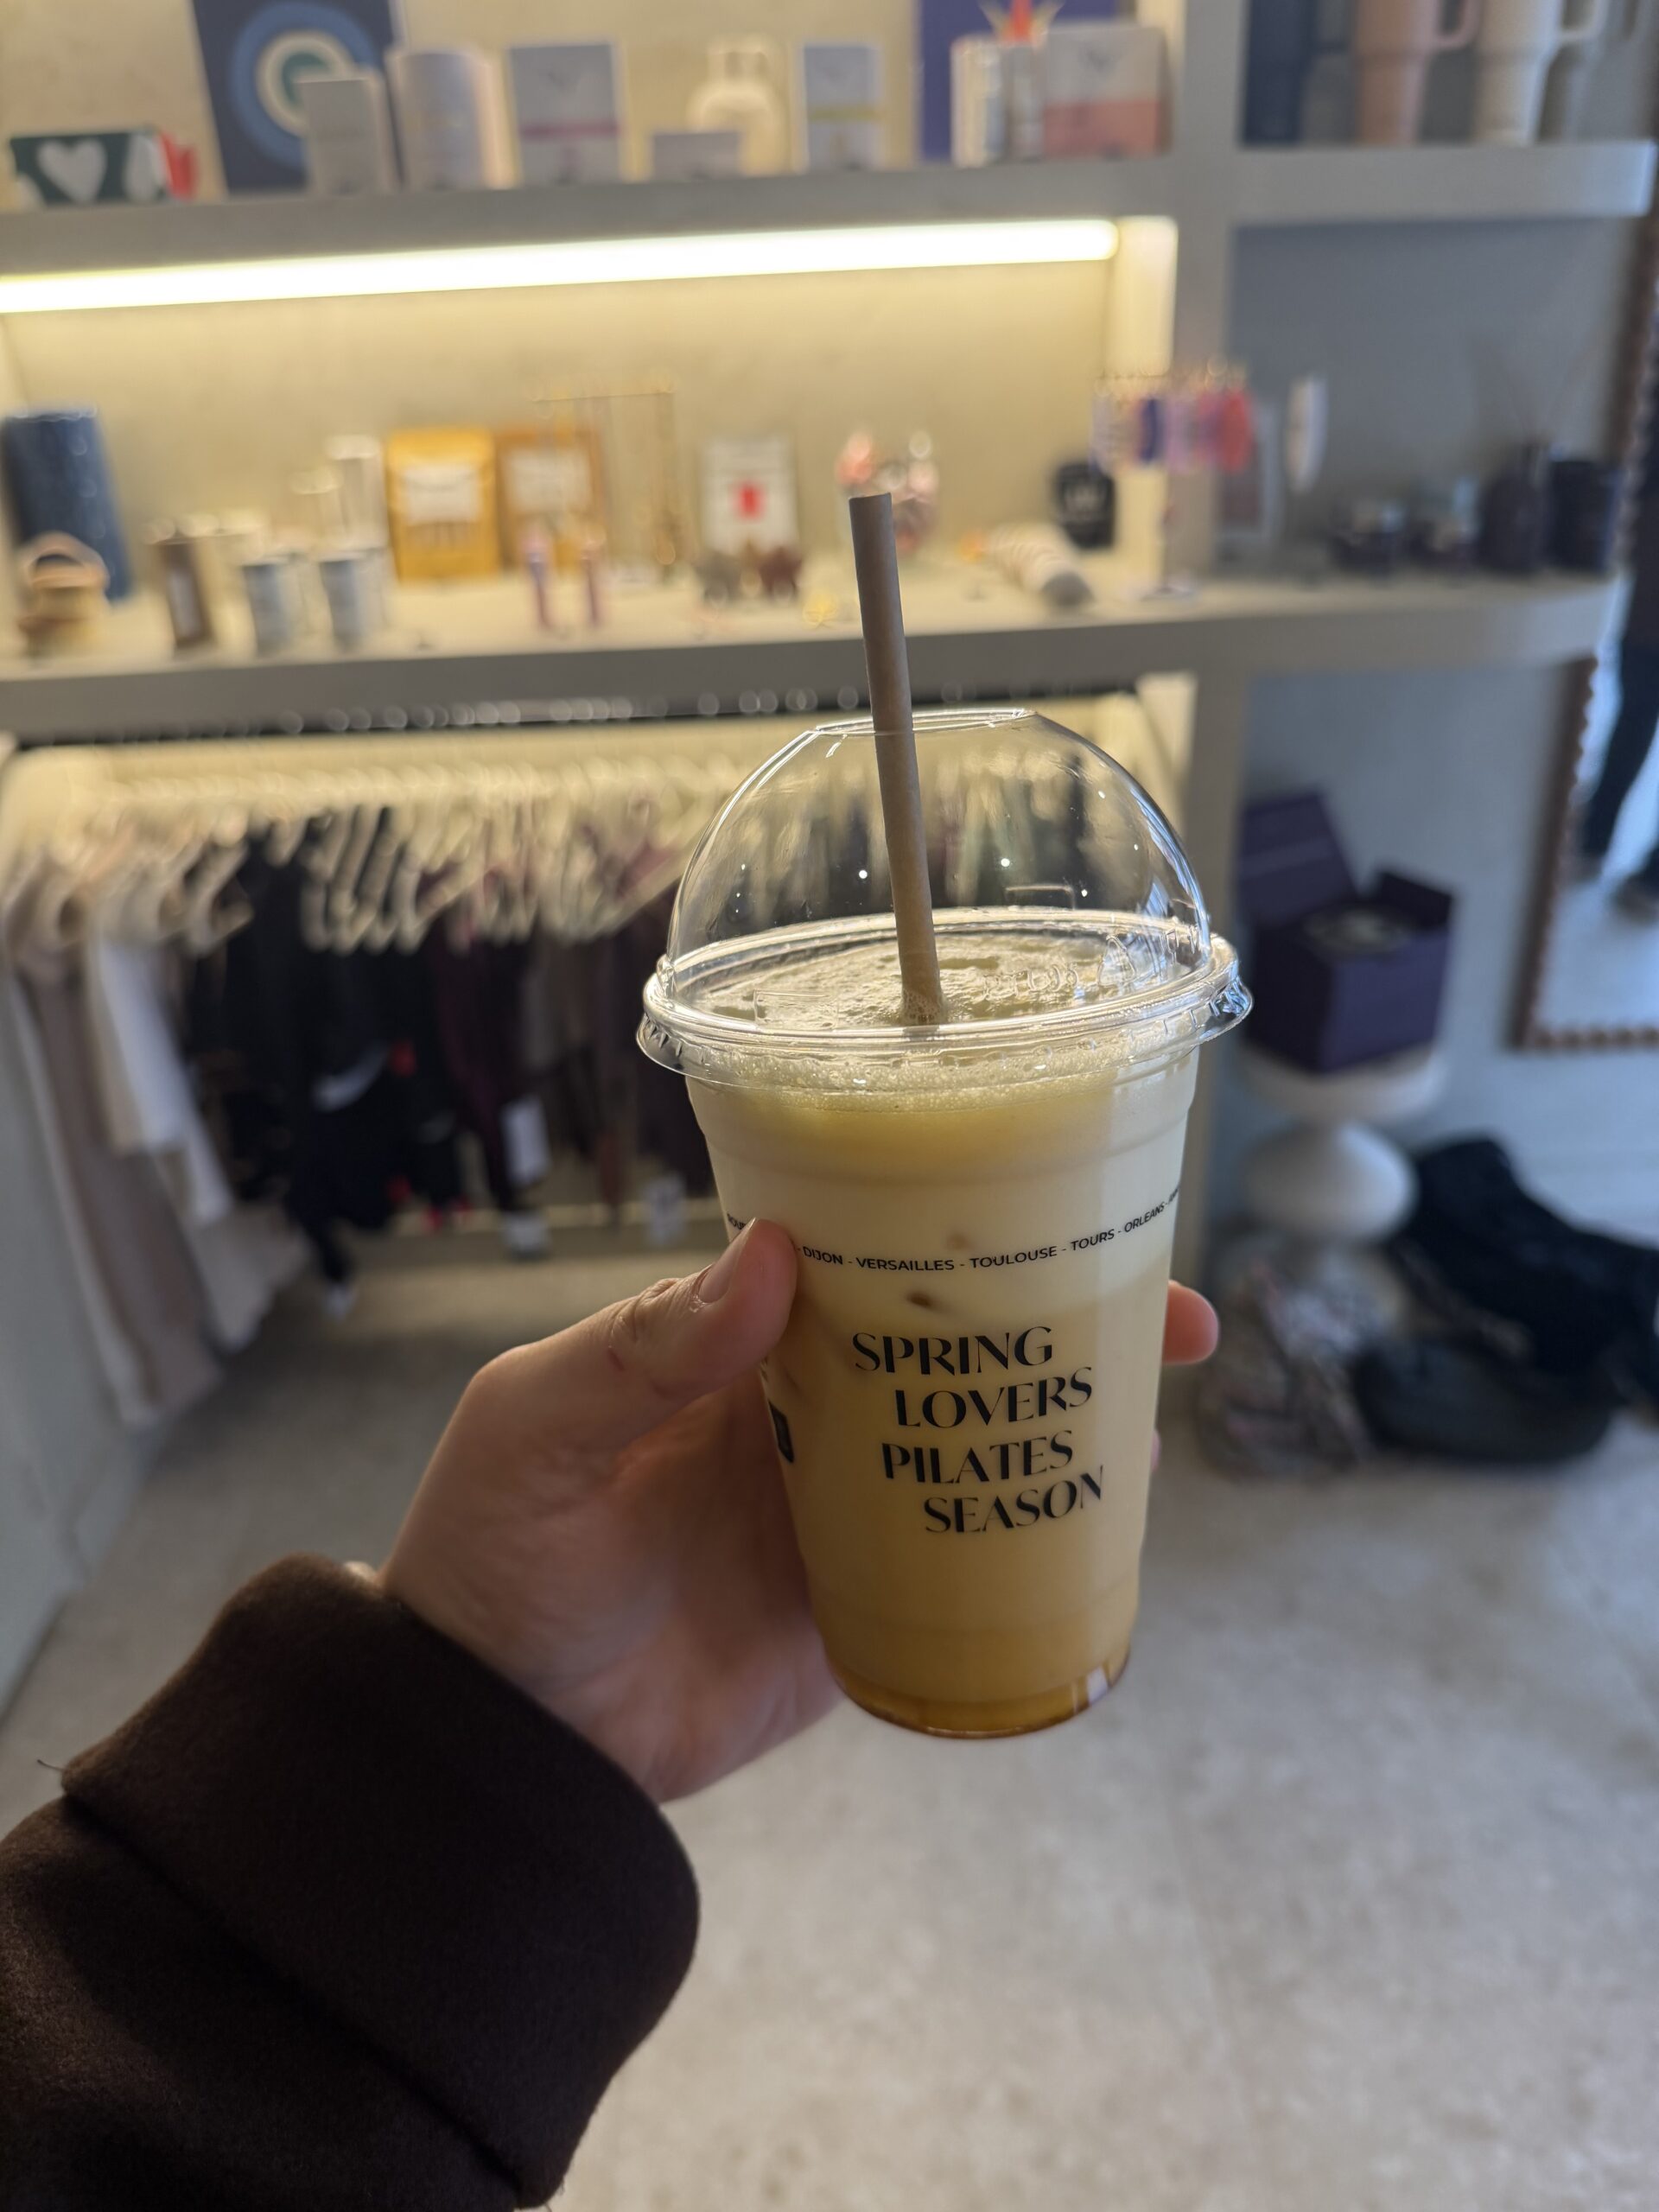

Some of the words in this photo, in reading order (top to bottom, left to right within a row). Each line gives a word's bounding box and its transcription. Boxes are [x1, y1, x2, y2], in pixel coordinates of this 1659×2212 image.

[803, 1246, 843, 1265] DIJON
[855, 1257, 955, 1271] VERSAILLES
[969, 1246, 1058, 1268] TOULOUSE
[1071, 1229, 1115, 1251] TOURS
[1124, 1201, 1165, 1233] ORLEANS
[852, 1325, 1053, 1376] SPRING
[895, 1367, 1093, 1428] LOVERS
[881, 1430, 1073, 1484] PILATES
[924, 1465, 1104, 1535] SEASON
